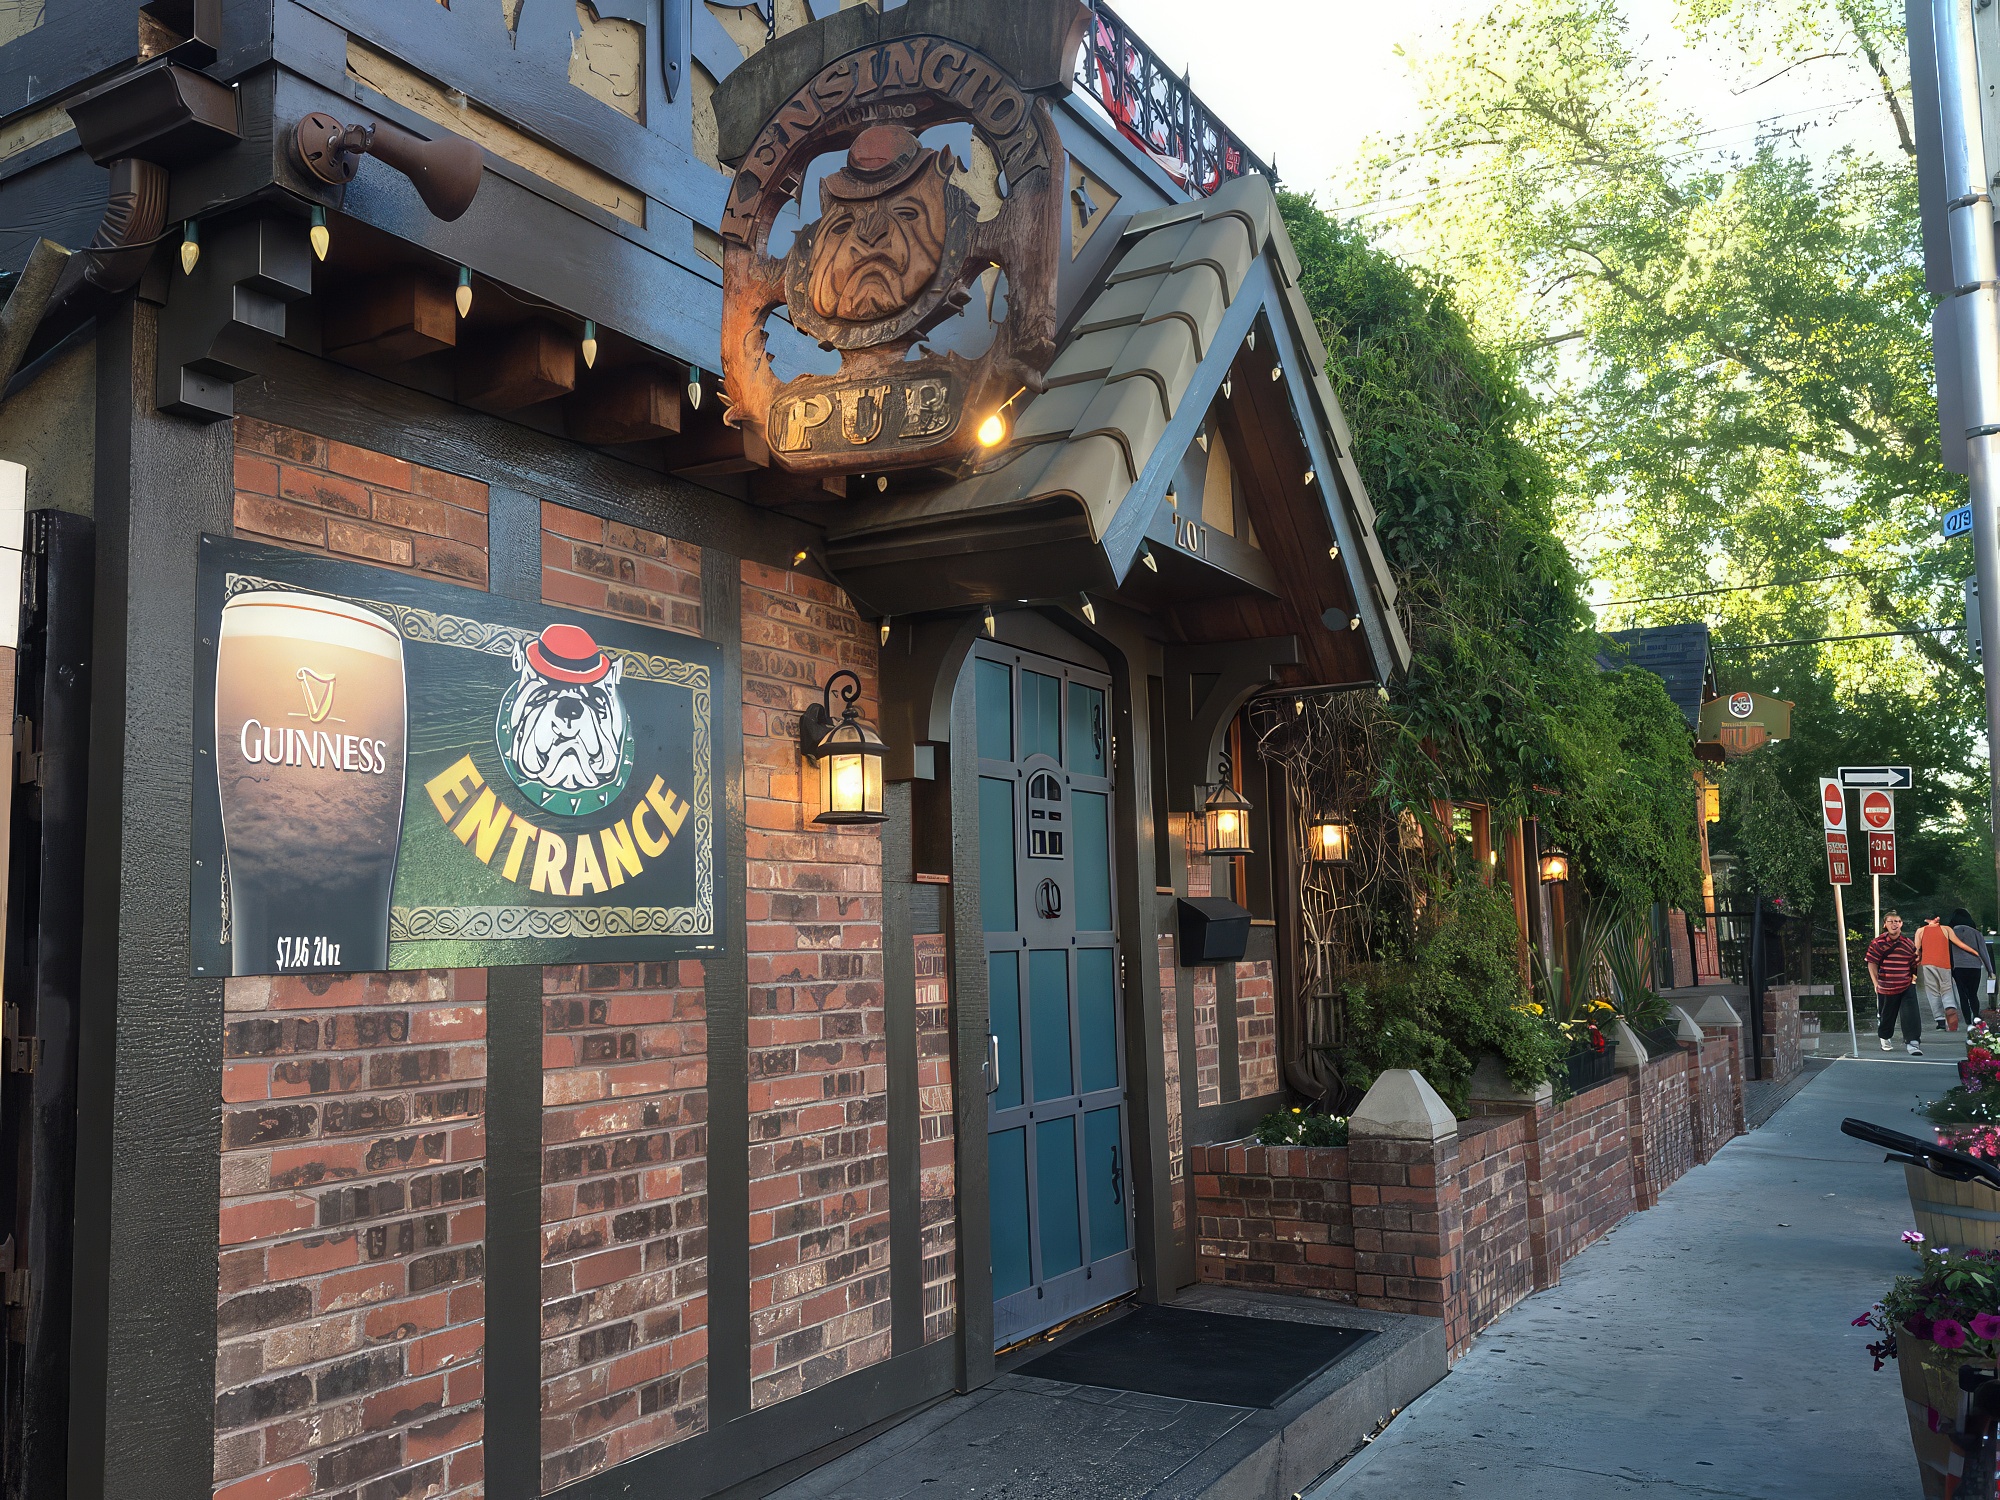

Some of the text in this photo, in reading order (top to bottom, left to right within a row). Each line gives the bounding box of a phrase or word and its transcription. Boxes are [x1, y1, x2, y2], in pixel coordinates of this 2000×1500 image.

[720, 38, 1049, 243] ENSINGTON
[779, 381, 952, 452] PUB
[240, 719, 387, 774] GUINNESS
[423, 754, 691, 896] ENTRANCE
